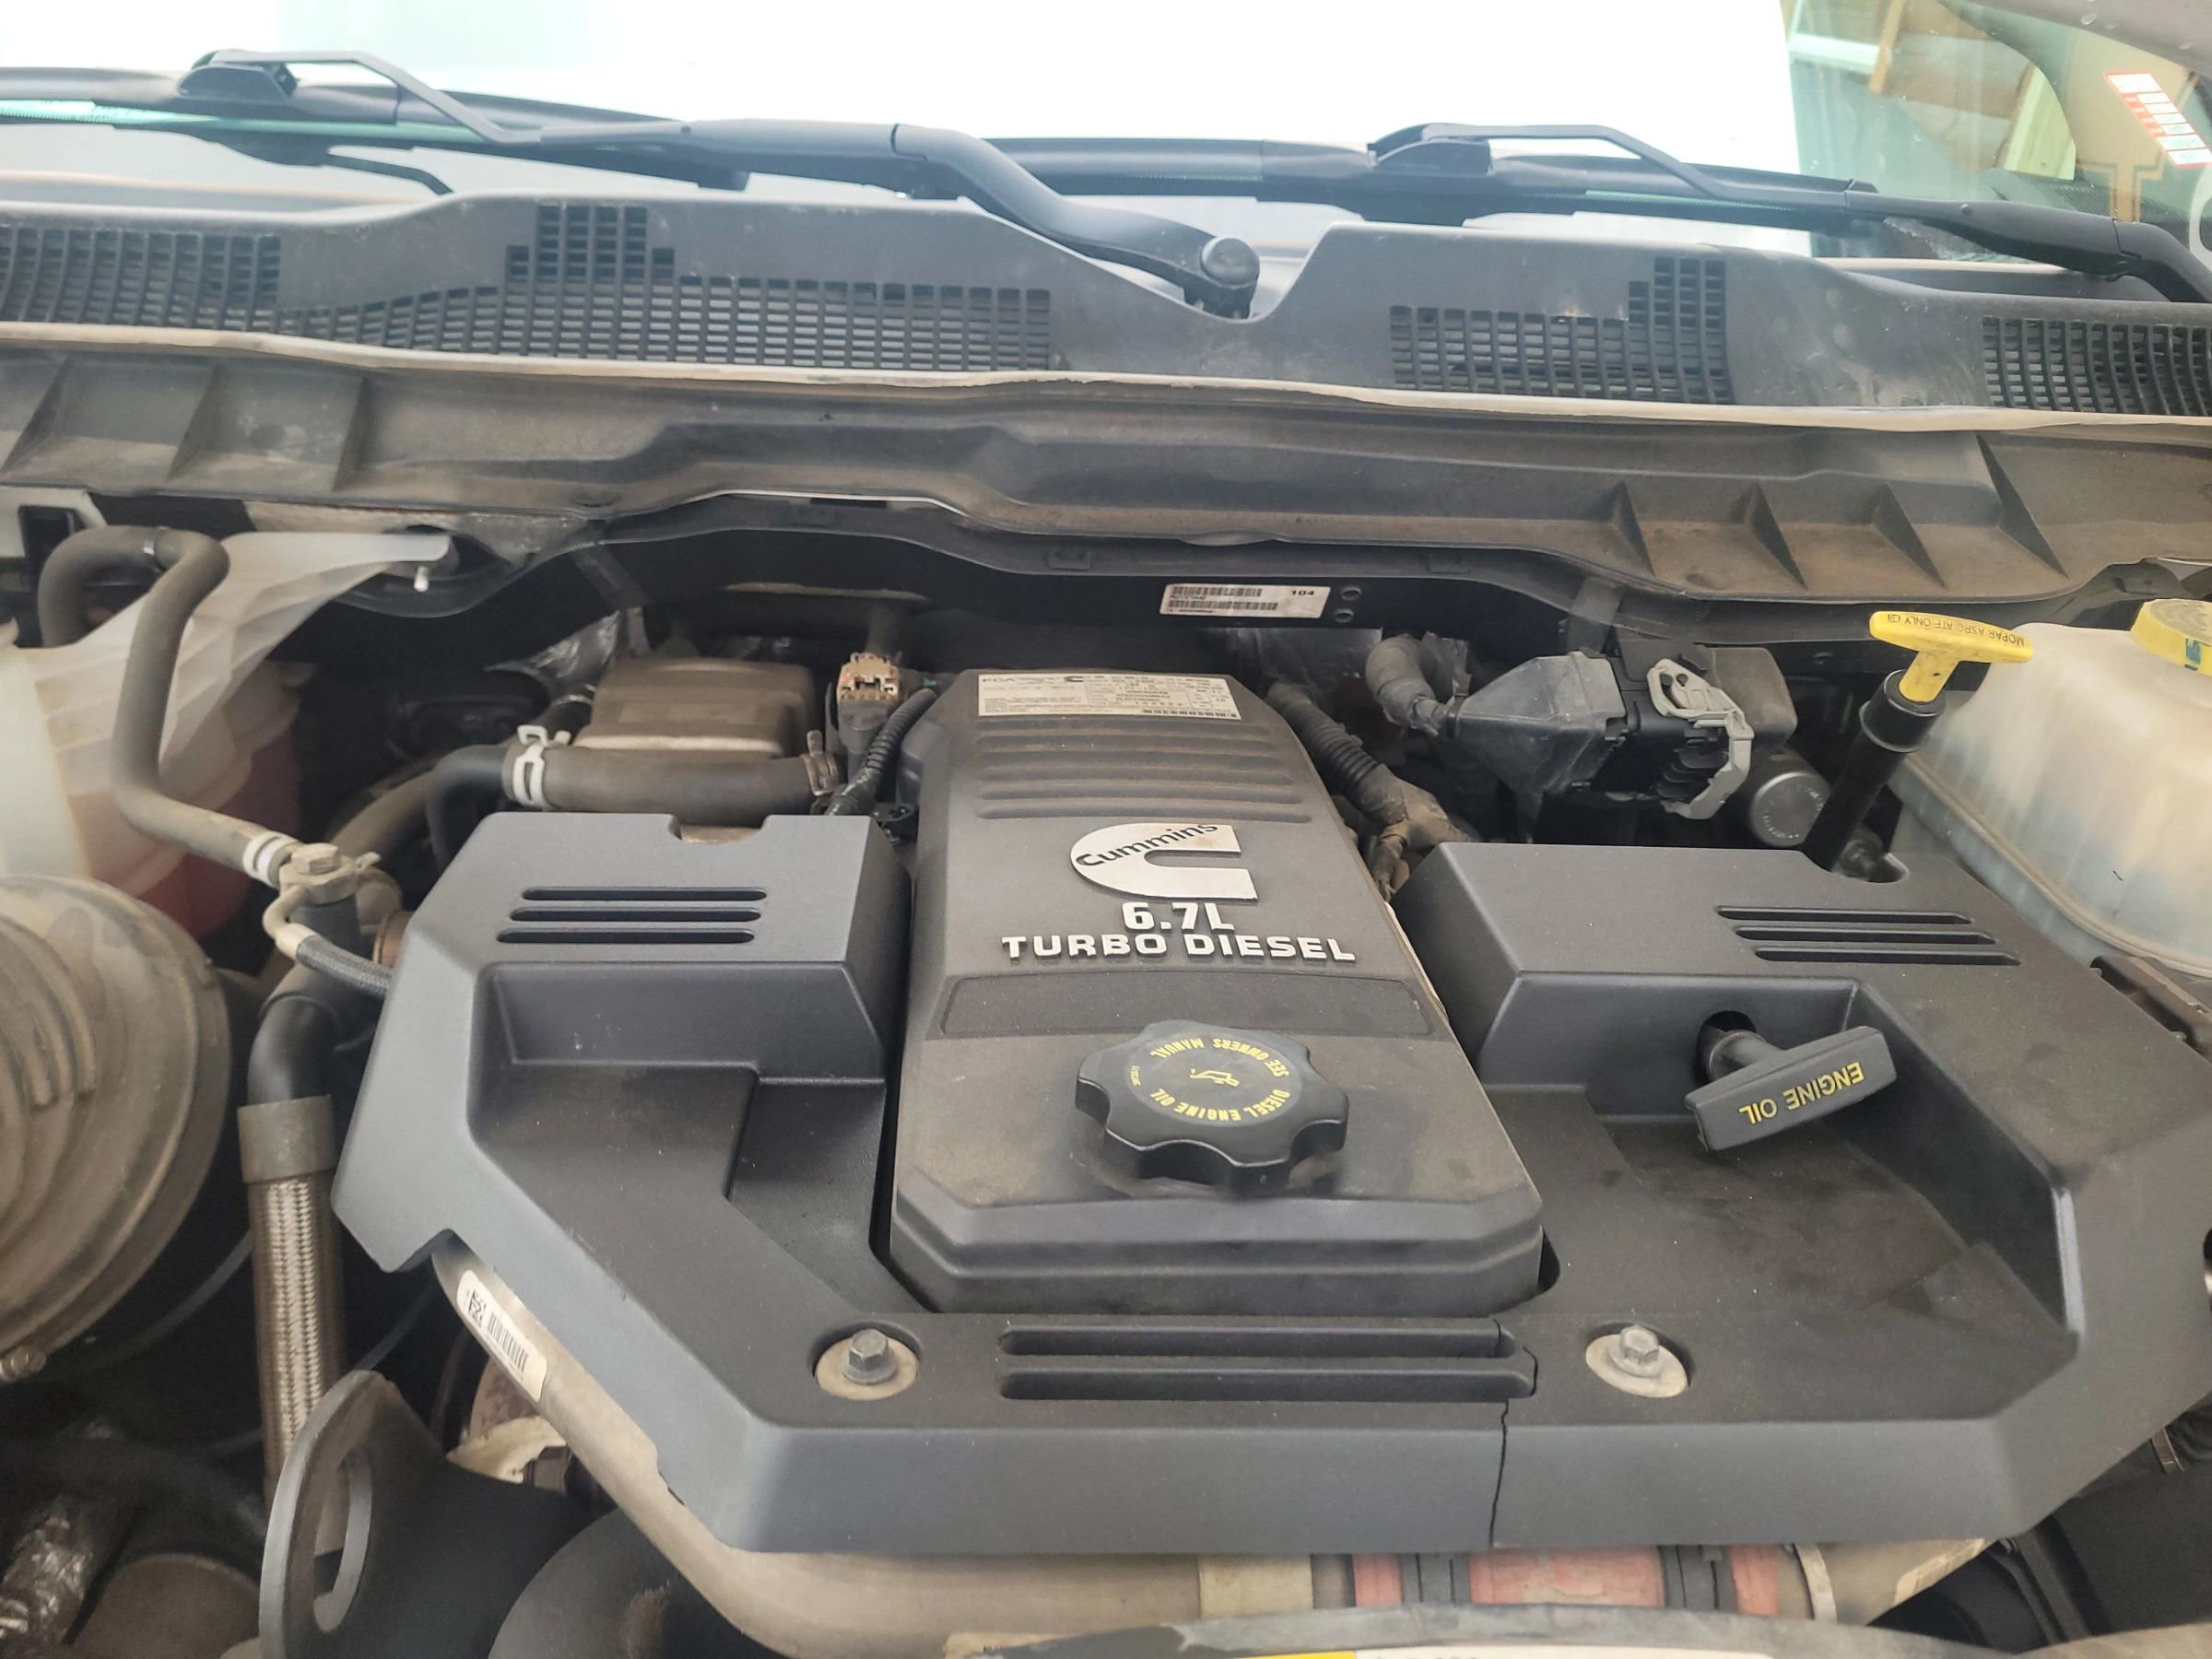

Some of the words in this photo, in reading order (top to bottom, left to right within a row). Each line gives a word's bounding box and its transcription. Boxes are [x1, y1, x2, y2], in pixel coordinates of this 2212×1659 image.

[1904, 617, 1932, 628] ONLY
[1935, 621, 1953, 630] ATF
[1988, 630, 2026, 647] MOPAR
[1076, 823, 1218, 866] Cummins
[1121, 901, 1235, 931] 6.7L
[1001, 934, 1168, 959] TURBO
[1182, 934, 1357, 963] DIESEL
[1149, 1038, 1206, 1059] MANUAL
[1212, 1038, 1270, 1062] OWNERS
[1264, 1058, 1290, 1078] SEE
[1783, 1061, 1865, 1111] ENGINE
[1149, 1088, 1177, 1107] OIL
[1243, 1088, 1291, 1119] DIESEL
[1173, 1101, 1242, 1122] ENGINE
[1738, 1098, 1778, 1124] OIL
